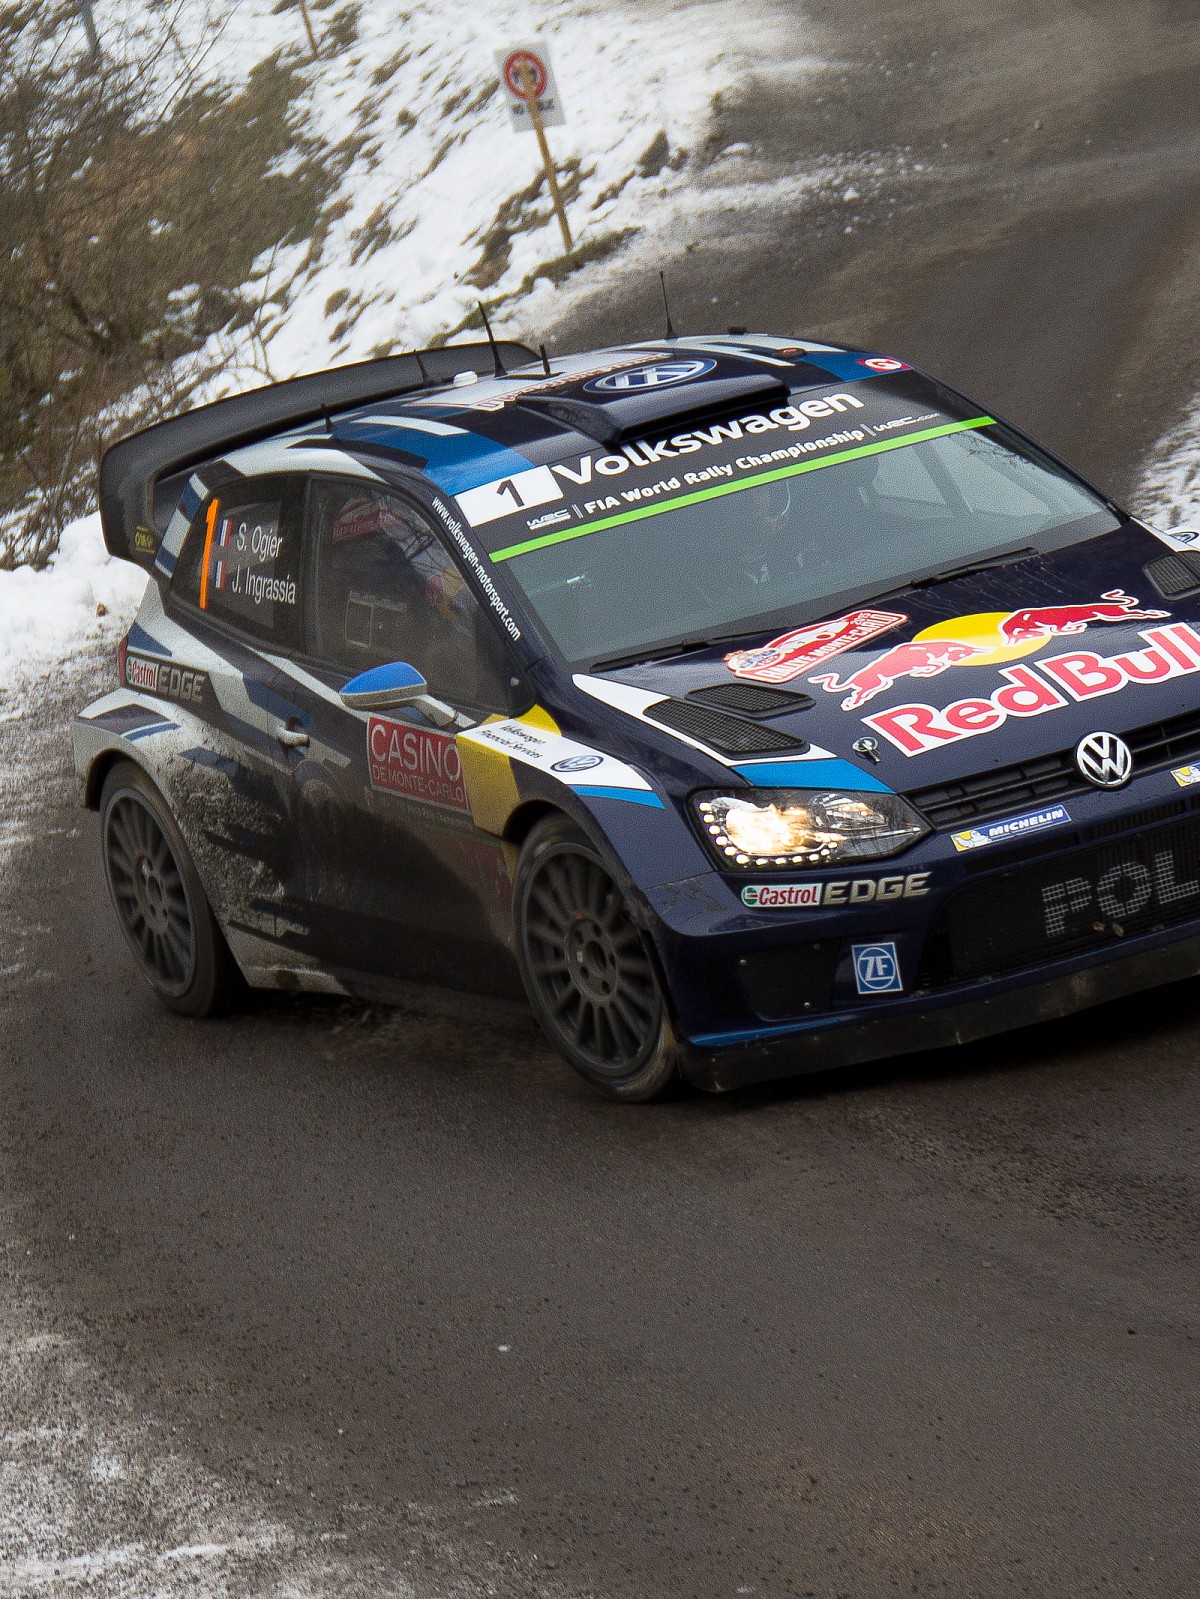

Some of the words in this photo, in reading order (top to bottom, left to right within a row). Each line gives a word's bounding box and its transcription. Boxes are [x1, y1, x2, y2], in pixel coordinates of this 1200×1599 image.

[551, 392, 865, 485] Volkswagen
[583, 496, 621, 514] FIA
[621, 477, 681, 502] World
[683, 464, 733, 486] Rally
[735, 428, 865, 469] Championship
[496, 479, 525, 507] 1
[200, 498, 219, 610] 1
[236, 522, 247, 551] S.
[251, 525, 283, 562] Ogier
[232, 565, 241, 593] J.
[245, 566, 296, 604] Ingrassia
[431, 497, 521, 641] www.volkswagen-motorsport.com
[131, 660, 157, 689] Castrol
[158, 665, 207, 703] EDGE
[865, 665, 1065, 755] Red
[371, 724, 460, 782] CASINO
[372, 764, 387, 782] DE
[388, 768, 464, 802] MONTE-CARLO
[988, 809, 1064, 836] MICHELIN
[758, 886, 818, 905] Castrol
[822, 871, 933, 905] EDGE
[859, 955, 893, 981] ZF
